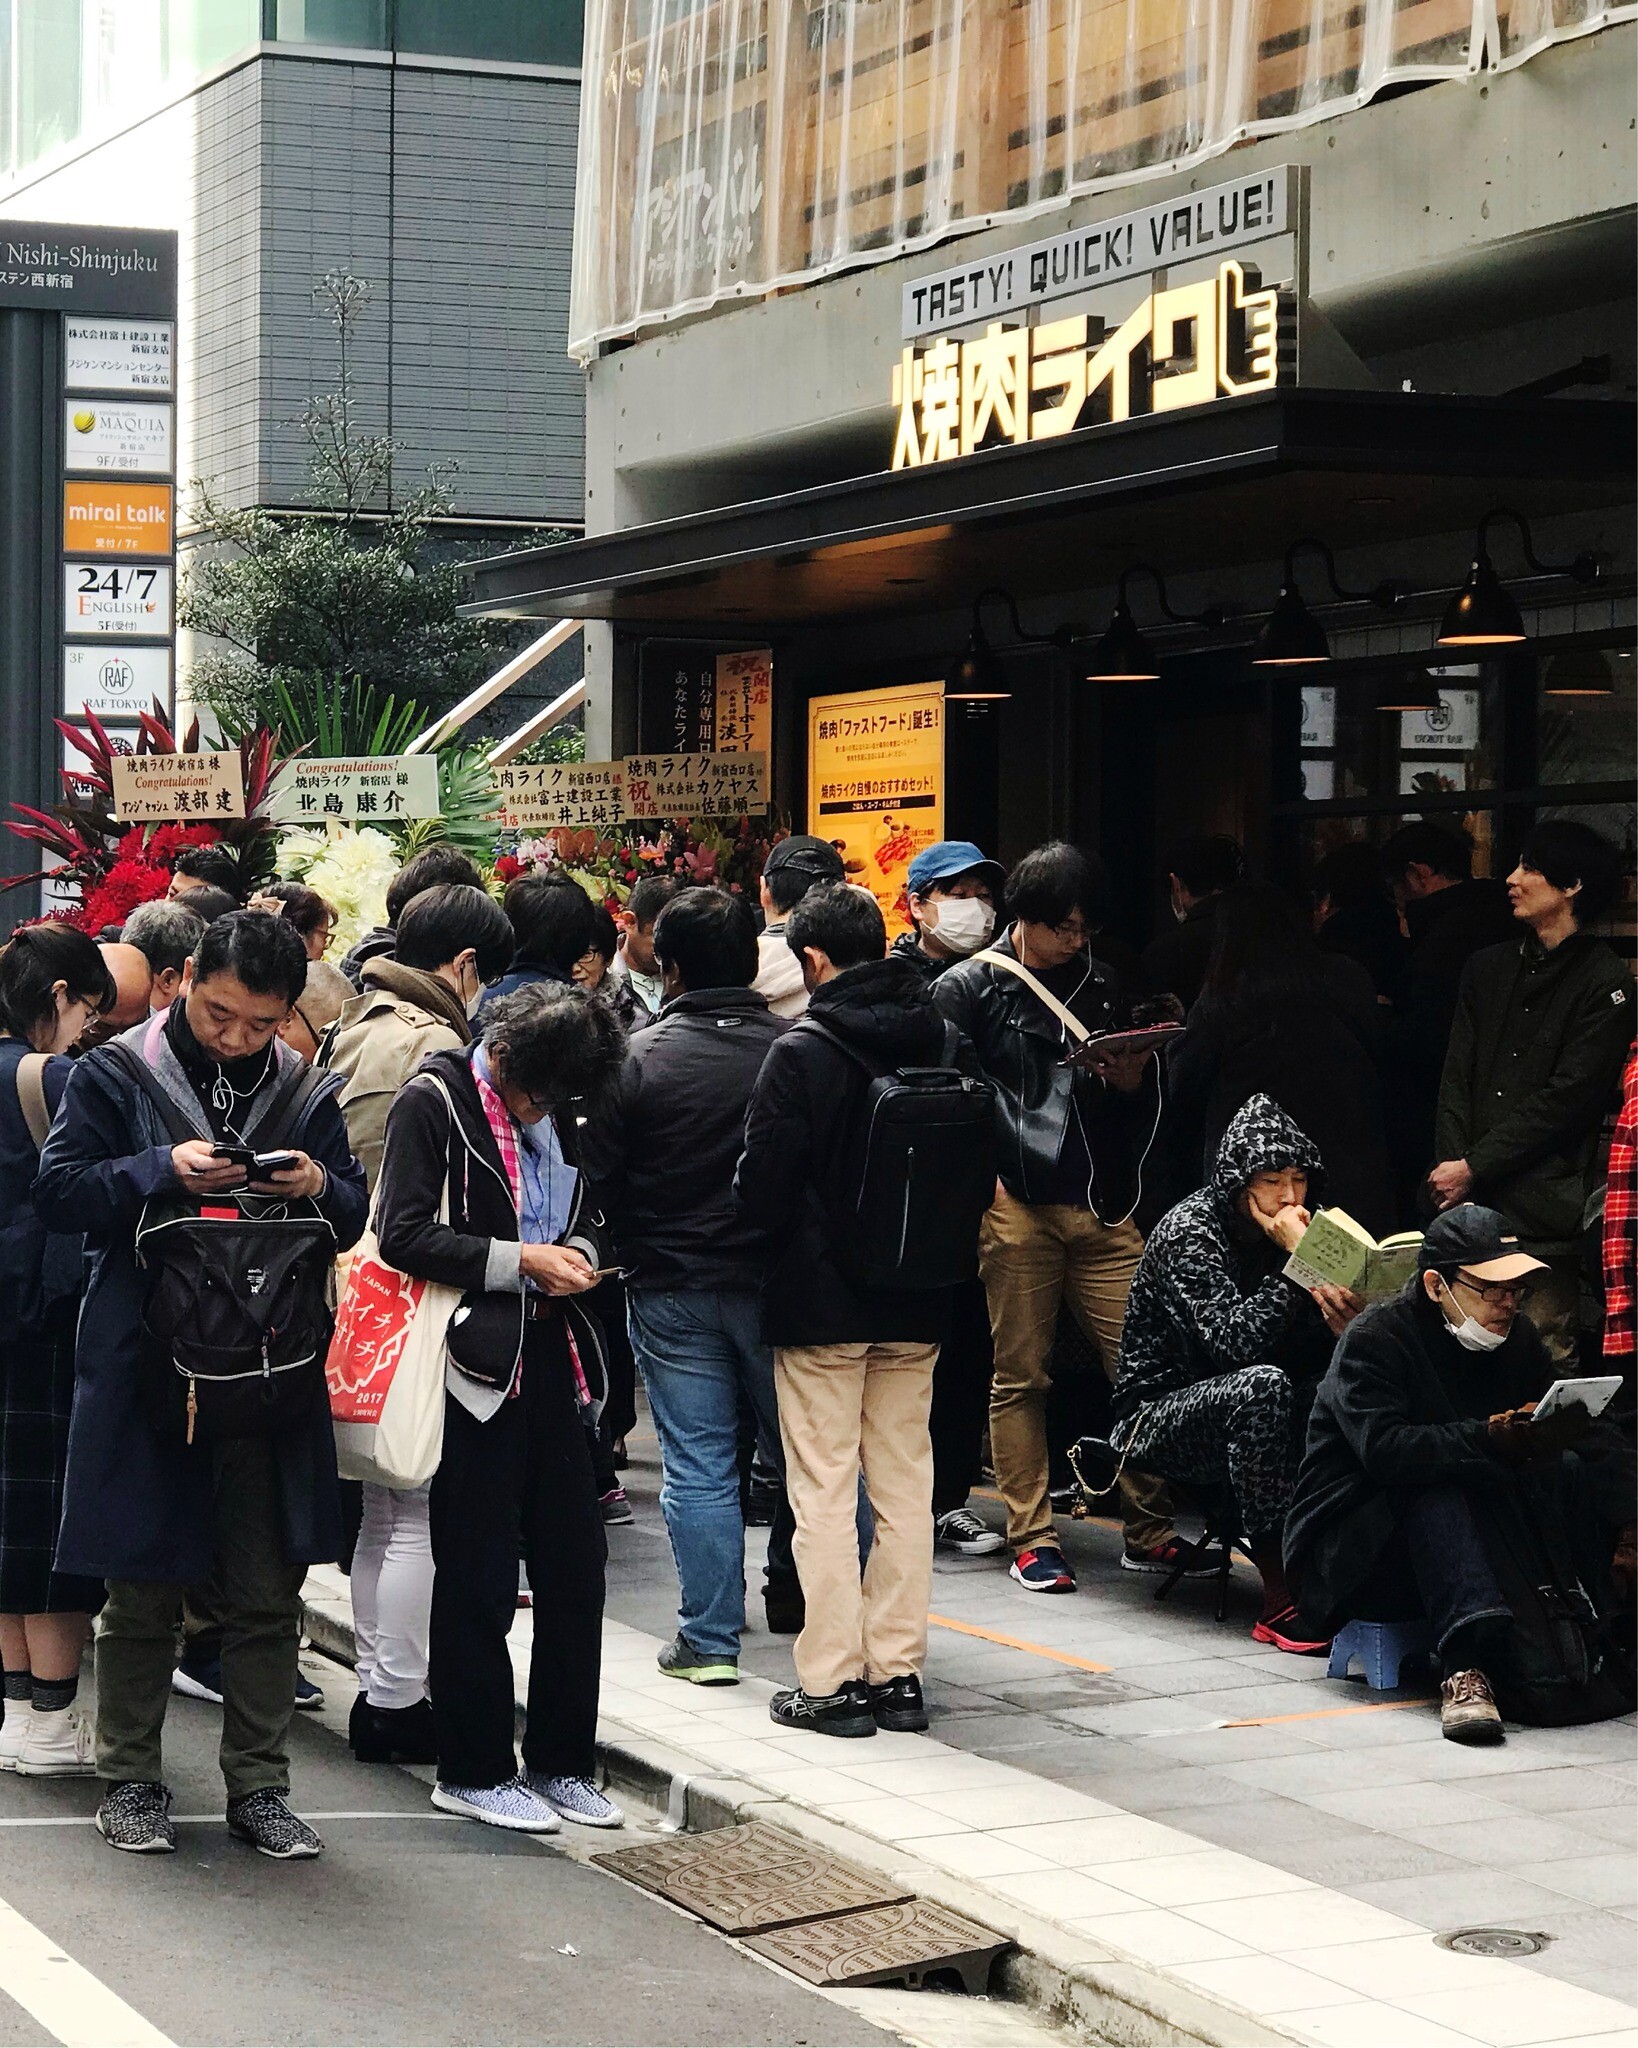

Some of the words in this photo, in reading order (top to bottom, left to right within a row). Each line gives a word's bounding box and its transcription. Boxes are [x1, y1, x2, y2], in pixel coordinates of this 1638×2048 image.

[6, 242, 159, 277] Nishi-Shinjuku
[911, 260, 1013, 326] TASTY!
[1030, 222, 1133, 294] QUICK!
[1149, 179, 1274, 257] VALUE!
[68, 328, 170, 343] 株式会社富士建設工業
[131, 343, 170, 355] 新宿支店
[68, 359, 170, 373] フジケンマンションセンター
[892, 278, 1218, 470] 焼肉ライク
[131, 373, 170, 385] 新宿支店
[99, 416, 166, 433] MAQUIA
[69, 502, 121, 522] mirai
[126, 504, 167, 524] talk
[77, 567, 158, 600] 24/7
[77, 595, 144, 616] ENGLISH
[69, 652, 85, 664] 3F
[105, 666, 129, 688] RAF
[85, 698, 108, 709] RAF
[108, 698, 148, 709] TOKYO
[818, 708, 940, 740] 焼肉「ファストフード」誕生!
[126, 758, 175, 773] 焼肉ライク
[176, 758, 206, 773] 新宿店
[208, 754, 222, 771] 様
[296, 759, 399, 776] Congratulations!
[627, 756, 711, 778] 焼肉ライク
[711, 762, 755, 777] 新宿西口店
[134, 774, 213, 791] Congratulations!
[295, 774, 351, 789] 焼肉ライク
[359, 774, 391, 787] 新宿店
[395, 772, 409, 786] 様
[492, 768, 563, 789] 肉ライク
[567, 770, 611, 787] 新宿西口店
[173, 788, 210, 813] 渡部
[215, 787, 234, 813] 建
[626, 777, 652, 802] 祝
[295, 792, 344, 815] 北島
[356, 789, 406, 814] 康介
[633, 801, 659, 817] 開店
[701, 796, 764, 816] 佐藤順一
[557, 803, 626, 826] 井上純子
[362, 1275, 392, 1298] JAPAN
[355, 1392, 384, 1404] 2017
